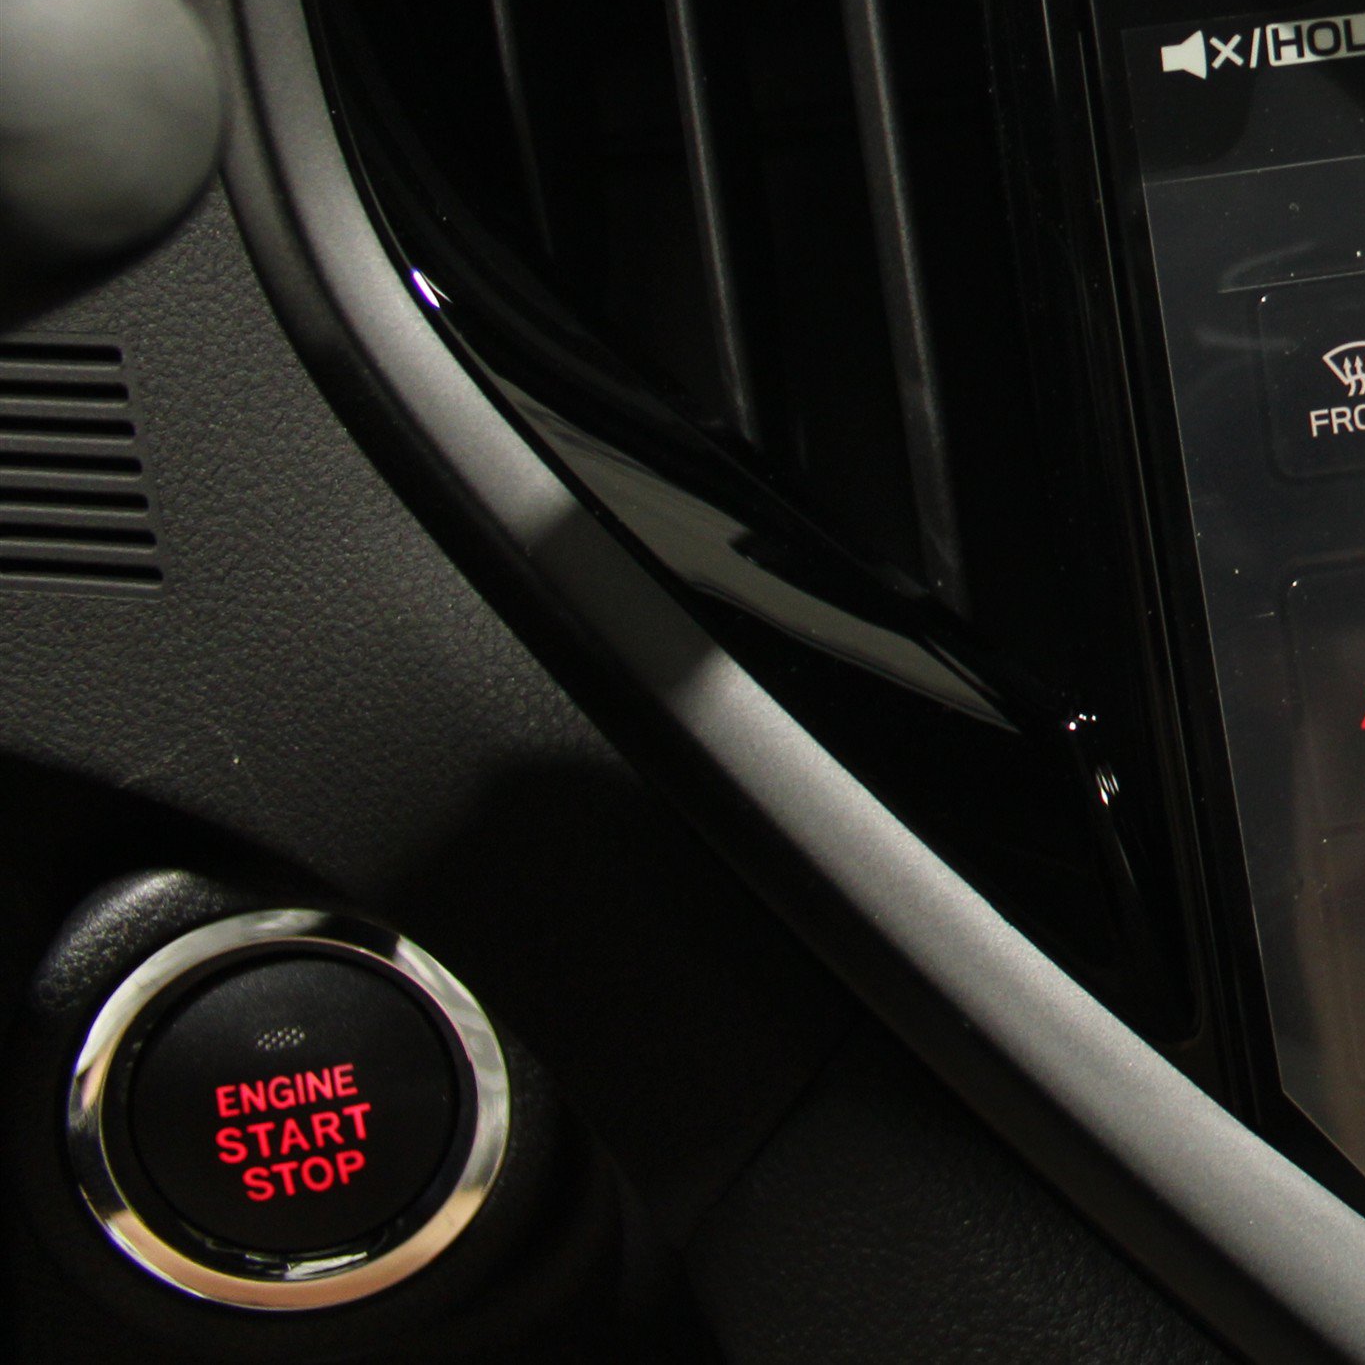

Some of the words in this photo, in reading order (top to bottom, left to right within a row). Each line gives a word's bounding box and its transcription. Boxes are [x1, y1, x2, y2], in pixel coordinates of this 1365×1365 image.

[214, 1063, 359, 1118] ENGINE
[214, 1102, 373, 1165] START
[241, 1149, 366, 1202] STOP
